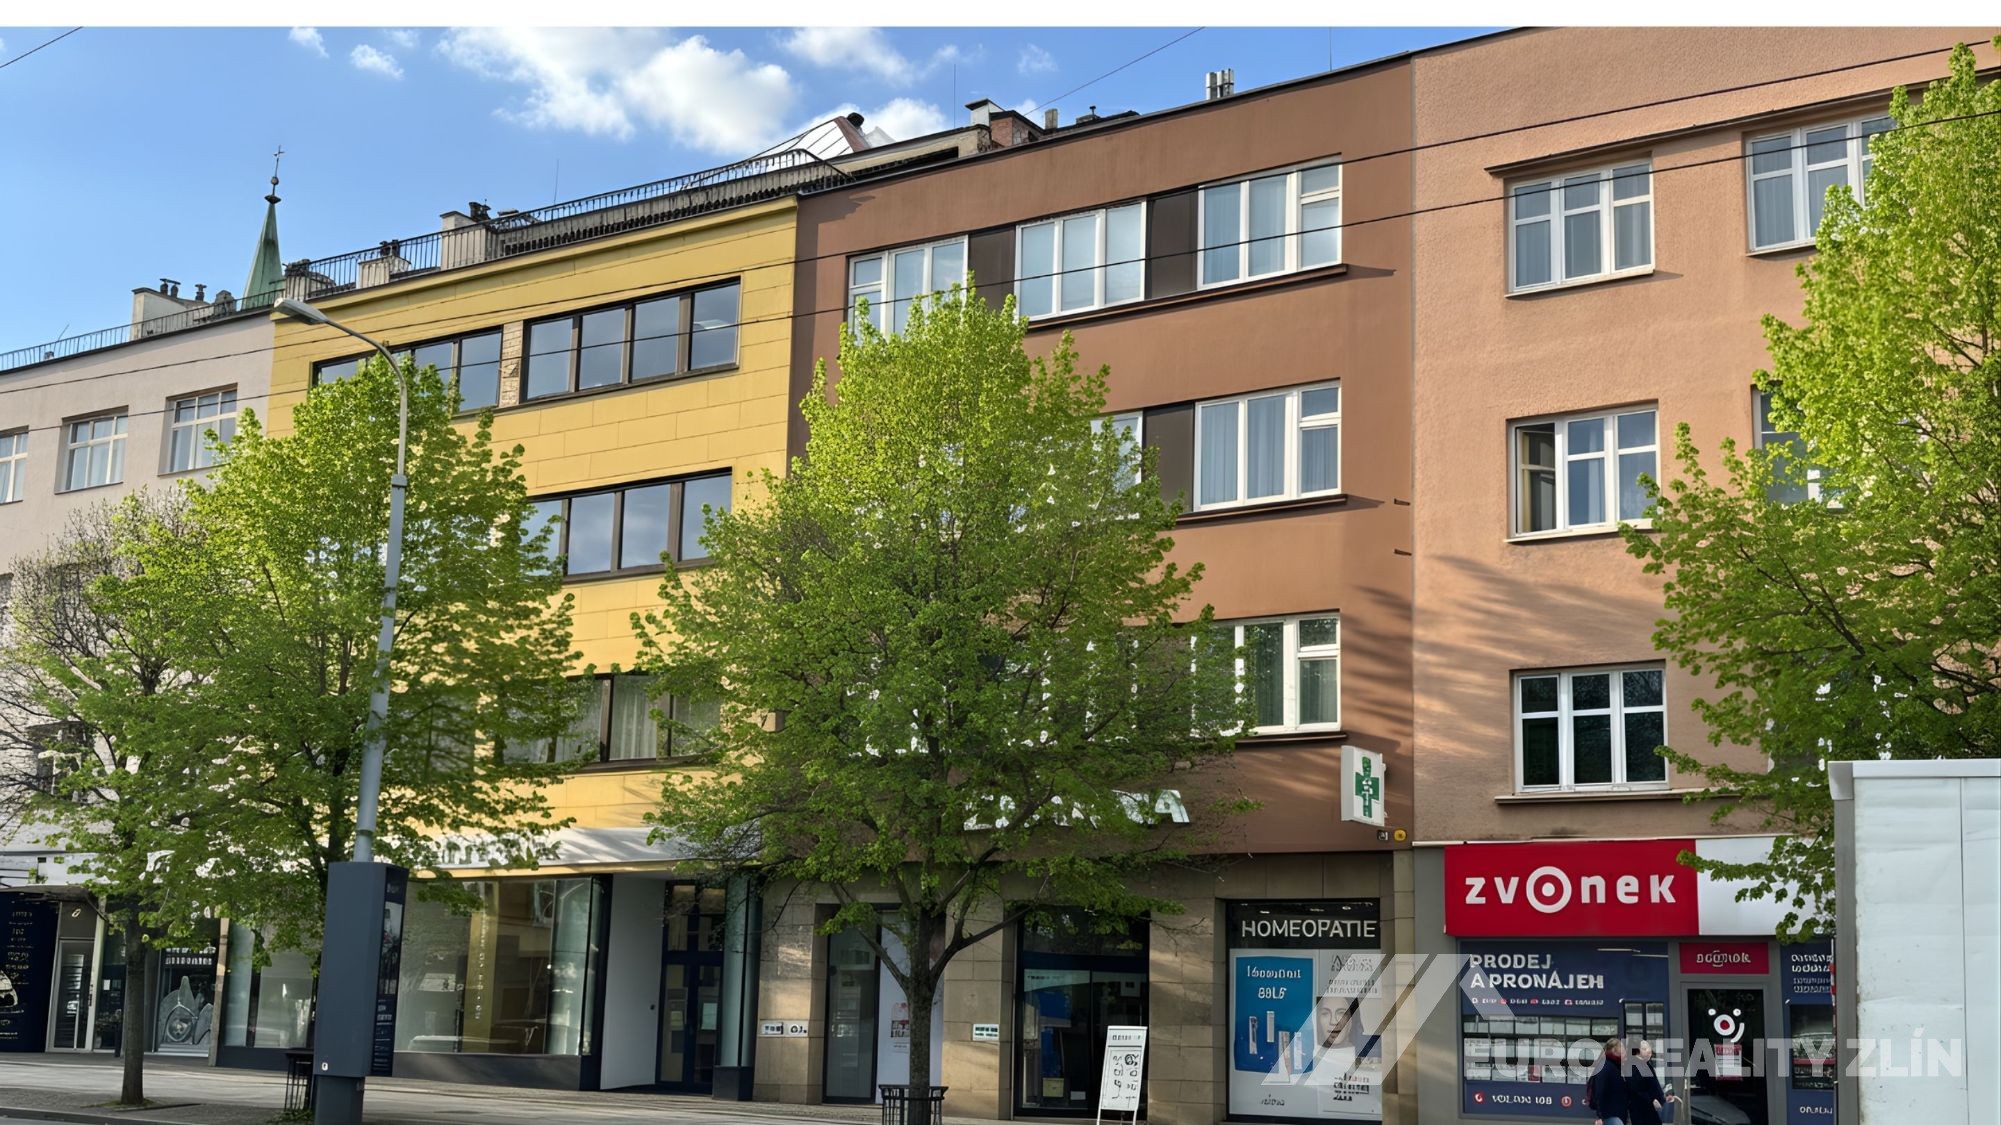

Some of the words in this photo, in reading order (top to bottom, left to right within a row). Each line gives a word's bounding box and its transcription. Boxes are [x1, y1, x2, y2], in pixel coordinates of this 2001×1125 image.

[1241, 919, 1377, 938] HOMEOPATIE
[1469, 953, 1552, 969] PRODEJ
[1470, 973, 1485, 989] A
